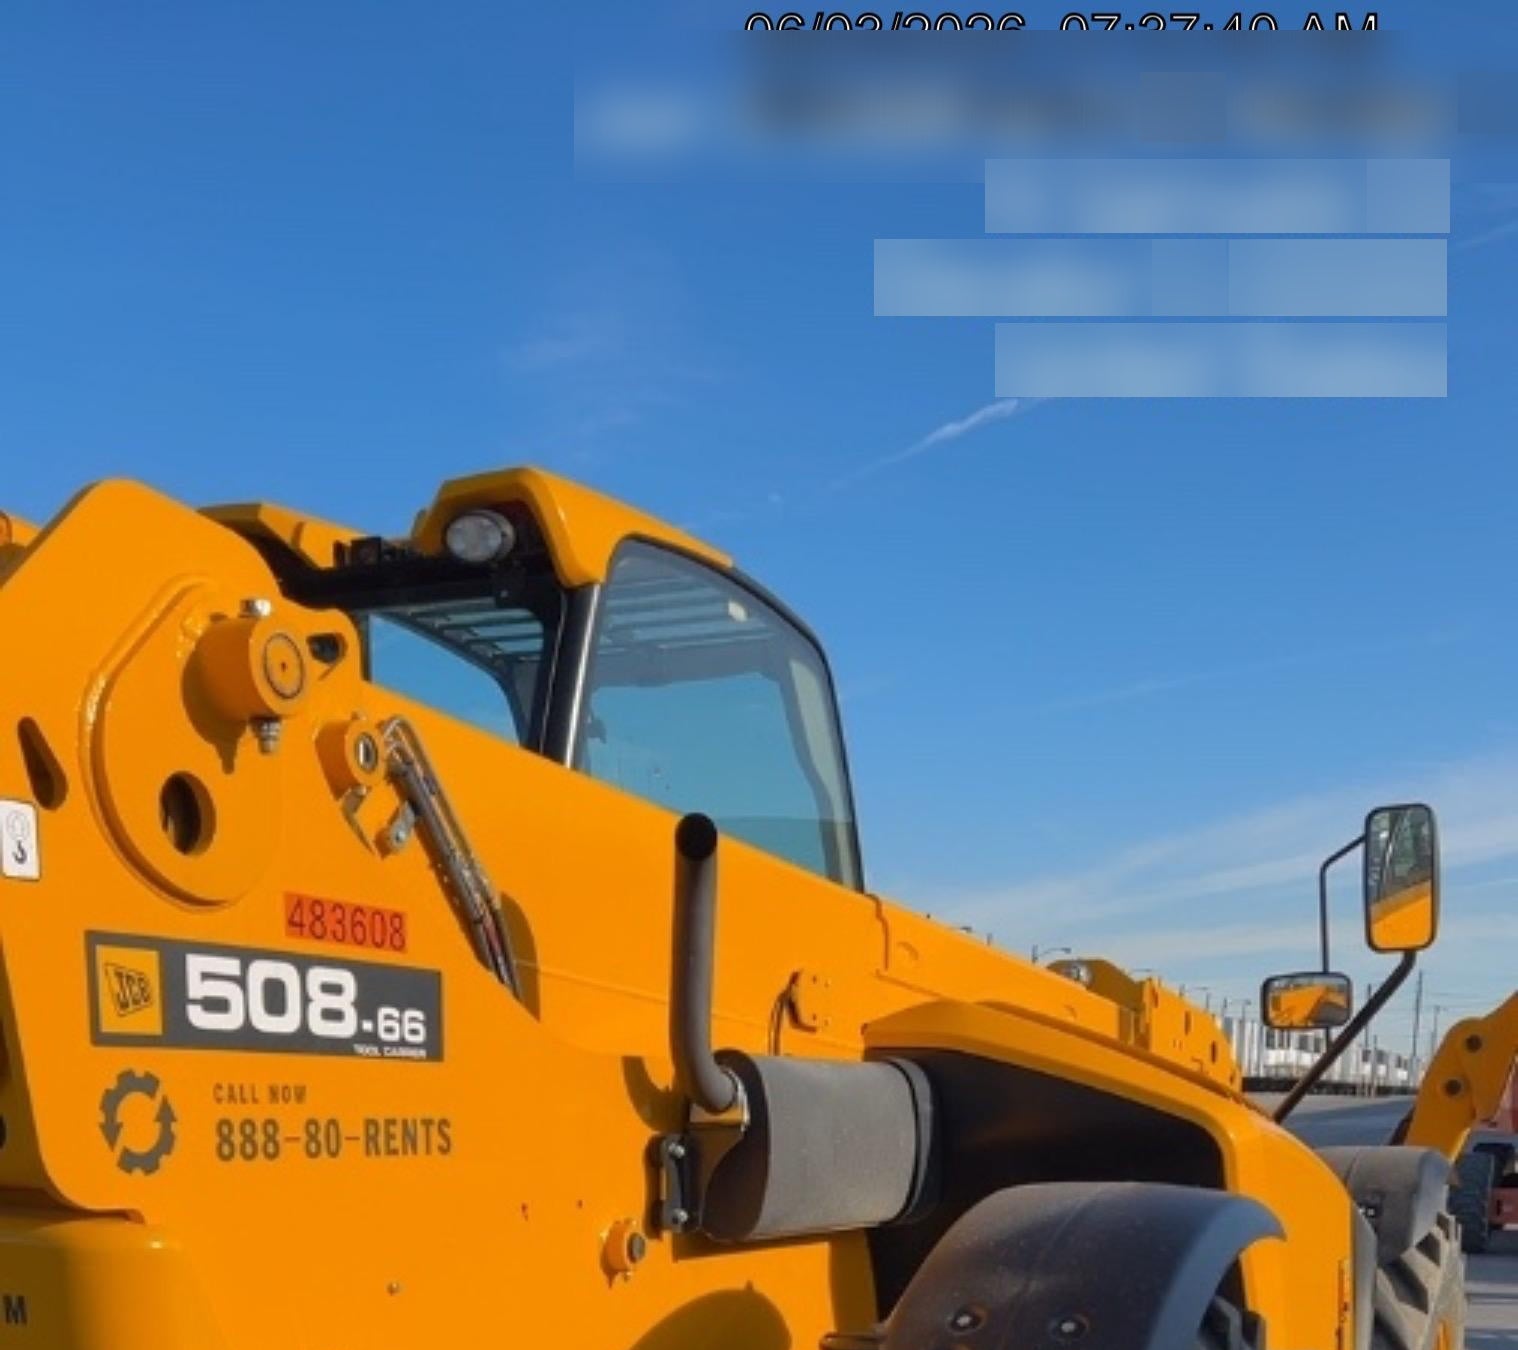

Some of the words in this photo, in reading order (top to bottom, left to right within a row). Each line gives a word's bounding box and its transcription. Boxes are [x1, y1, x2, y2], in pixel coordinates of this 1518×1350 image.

[287, 896, 406, 952] 483608
[213, 1083, 259, 1104] CALL
[269, 1085, 307, 1104] NOW
[216, 1118, 452, 1162] 888-80-RENTS
